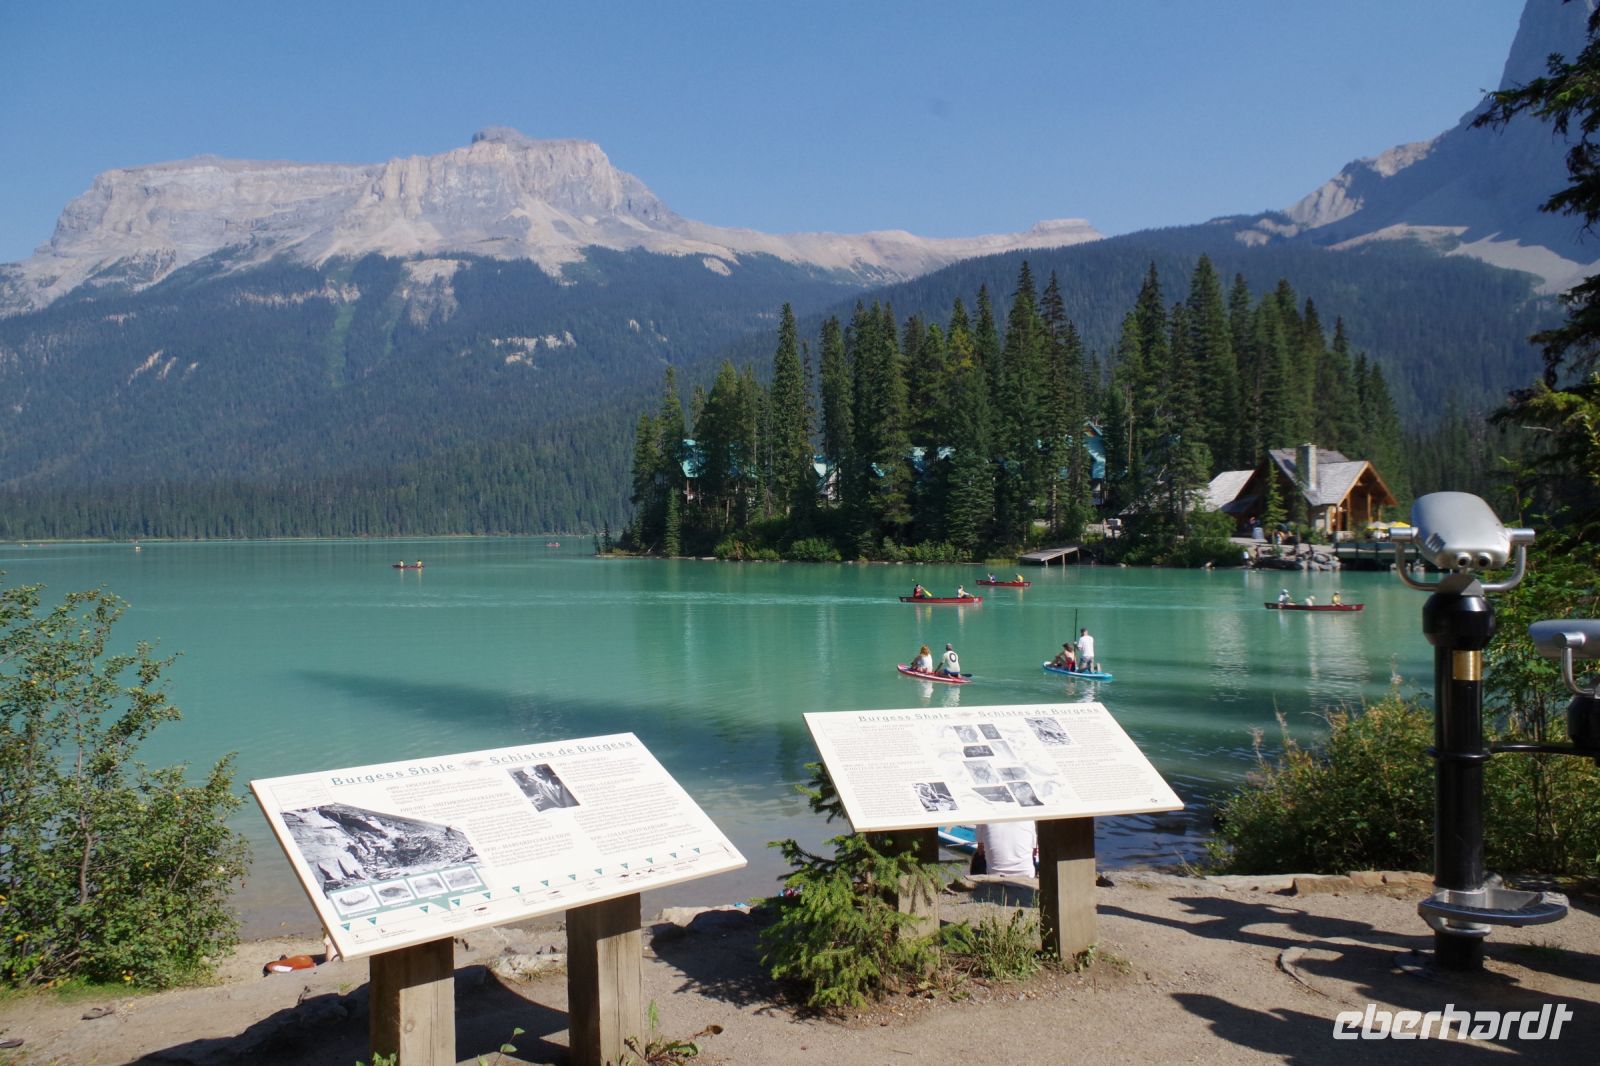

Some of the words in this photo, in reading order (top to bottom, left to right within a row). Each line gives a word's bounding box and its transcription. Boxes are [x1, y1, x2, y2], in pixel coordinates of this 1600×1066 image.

[858, 715, 911, 723] Burgess
[978, 710, 1031, 718] Schistes
[1034, 708, 1049, 716] de
[1051, 707, 1099, 716] Burgess
[489, 750, 554, 765] Schistes
[558, 746, 574, 756] de
[576, 740, 633, 753] Burgess
[331, 771, 404, 786] Burgess
[408, 763, 455, 776] Shale
